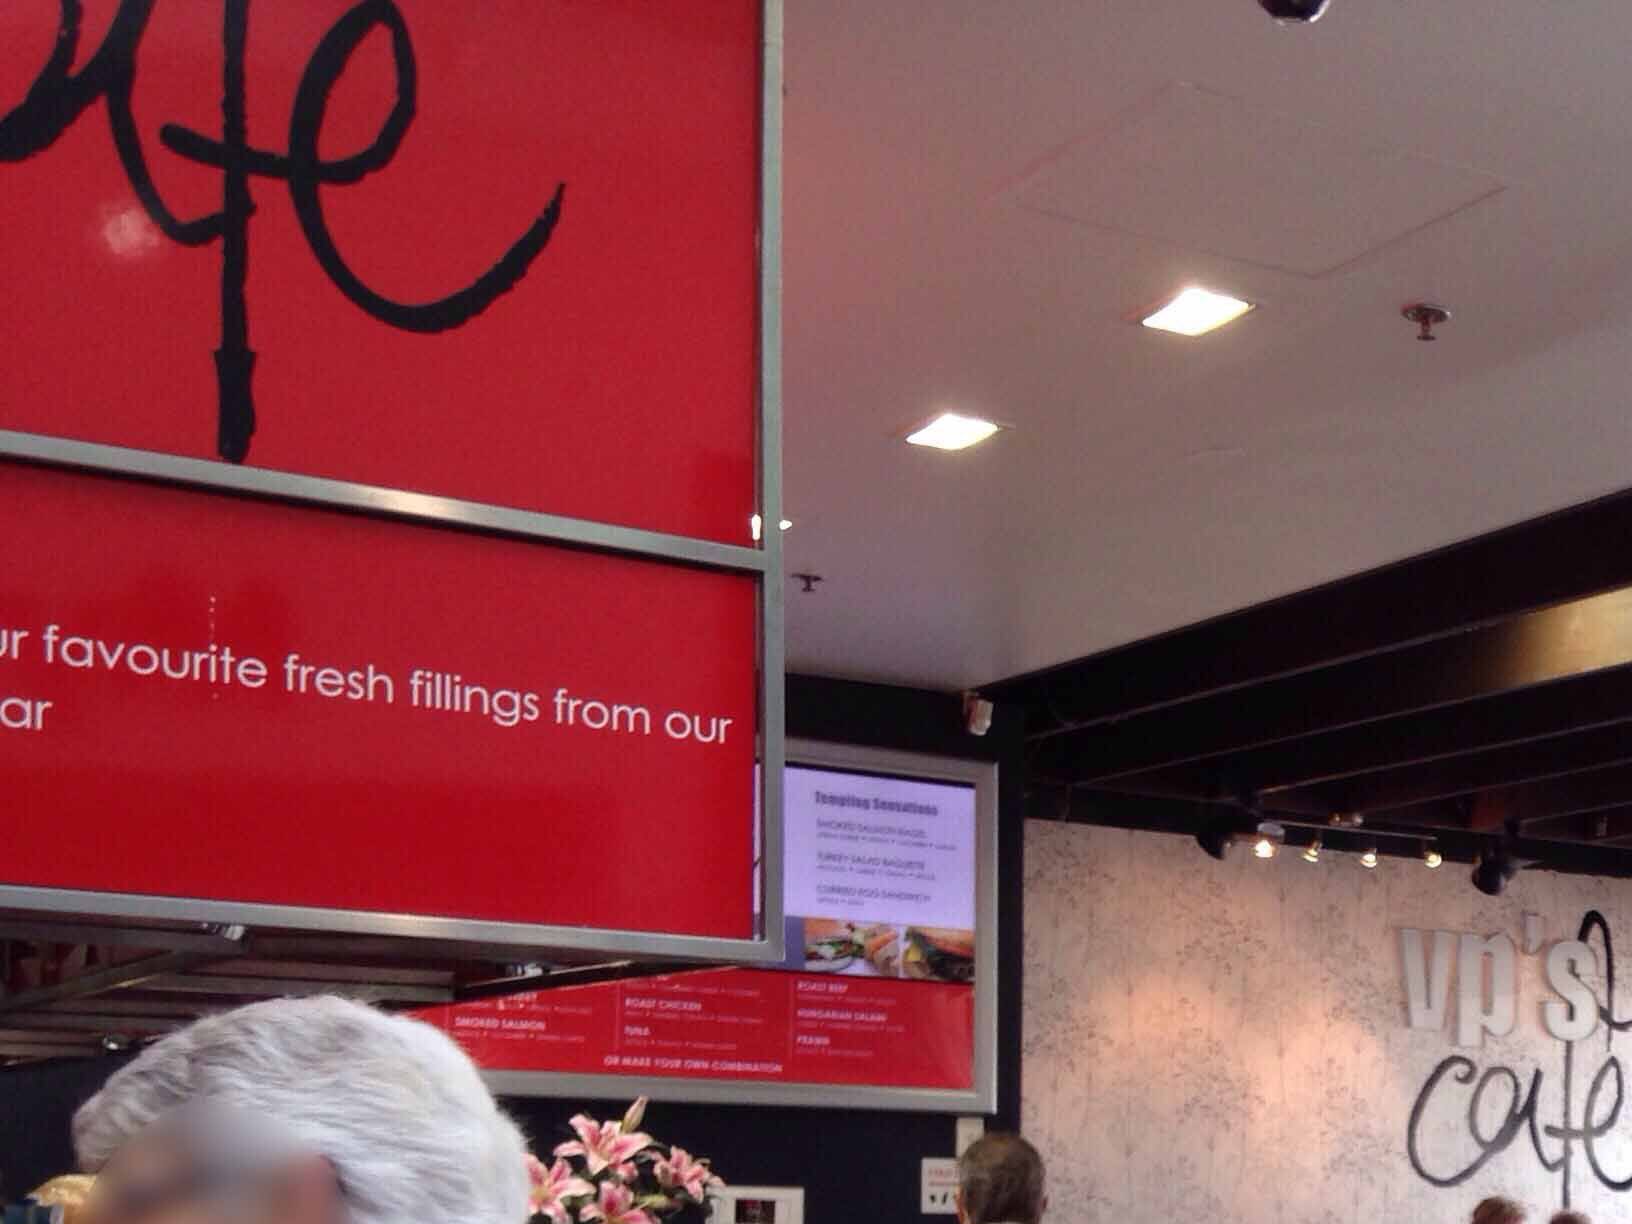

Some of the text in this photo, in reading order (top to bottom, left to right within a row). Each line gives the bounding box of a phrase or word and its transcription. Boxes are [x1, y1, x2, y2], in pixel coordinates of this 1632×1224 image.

[42, 624, 269, 688] favourite
[283, 653, 395, 704] fresh
[410, 669, 540, 727] fillings
[554, 688, 651, 735] from
[665, 711, 733, 744] our
[455, 1016, 499, 1029] SMOKED
